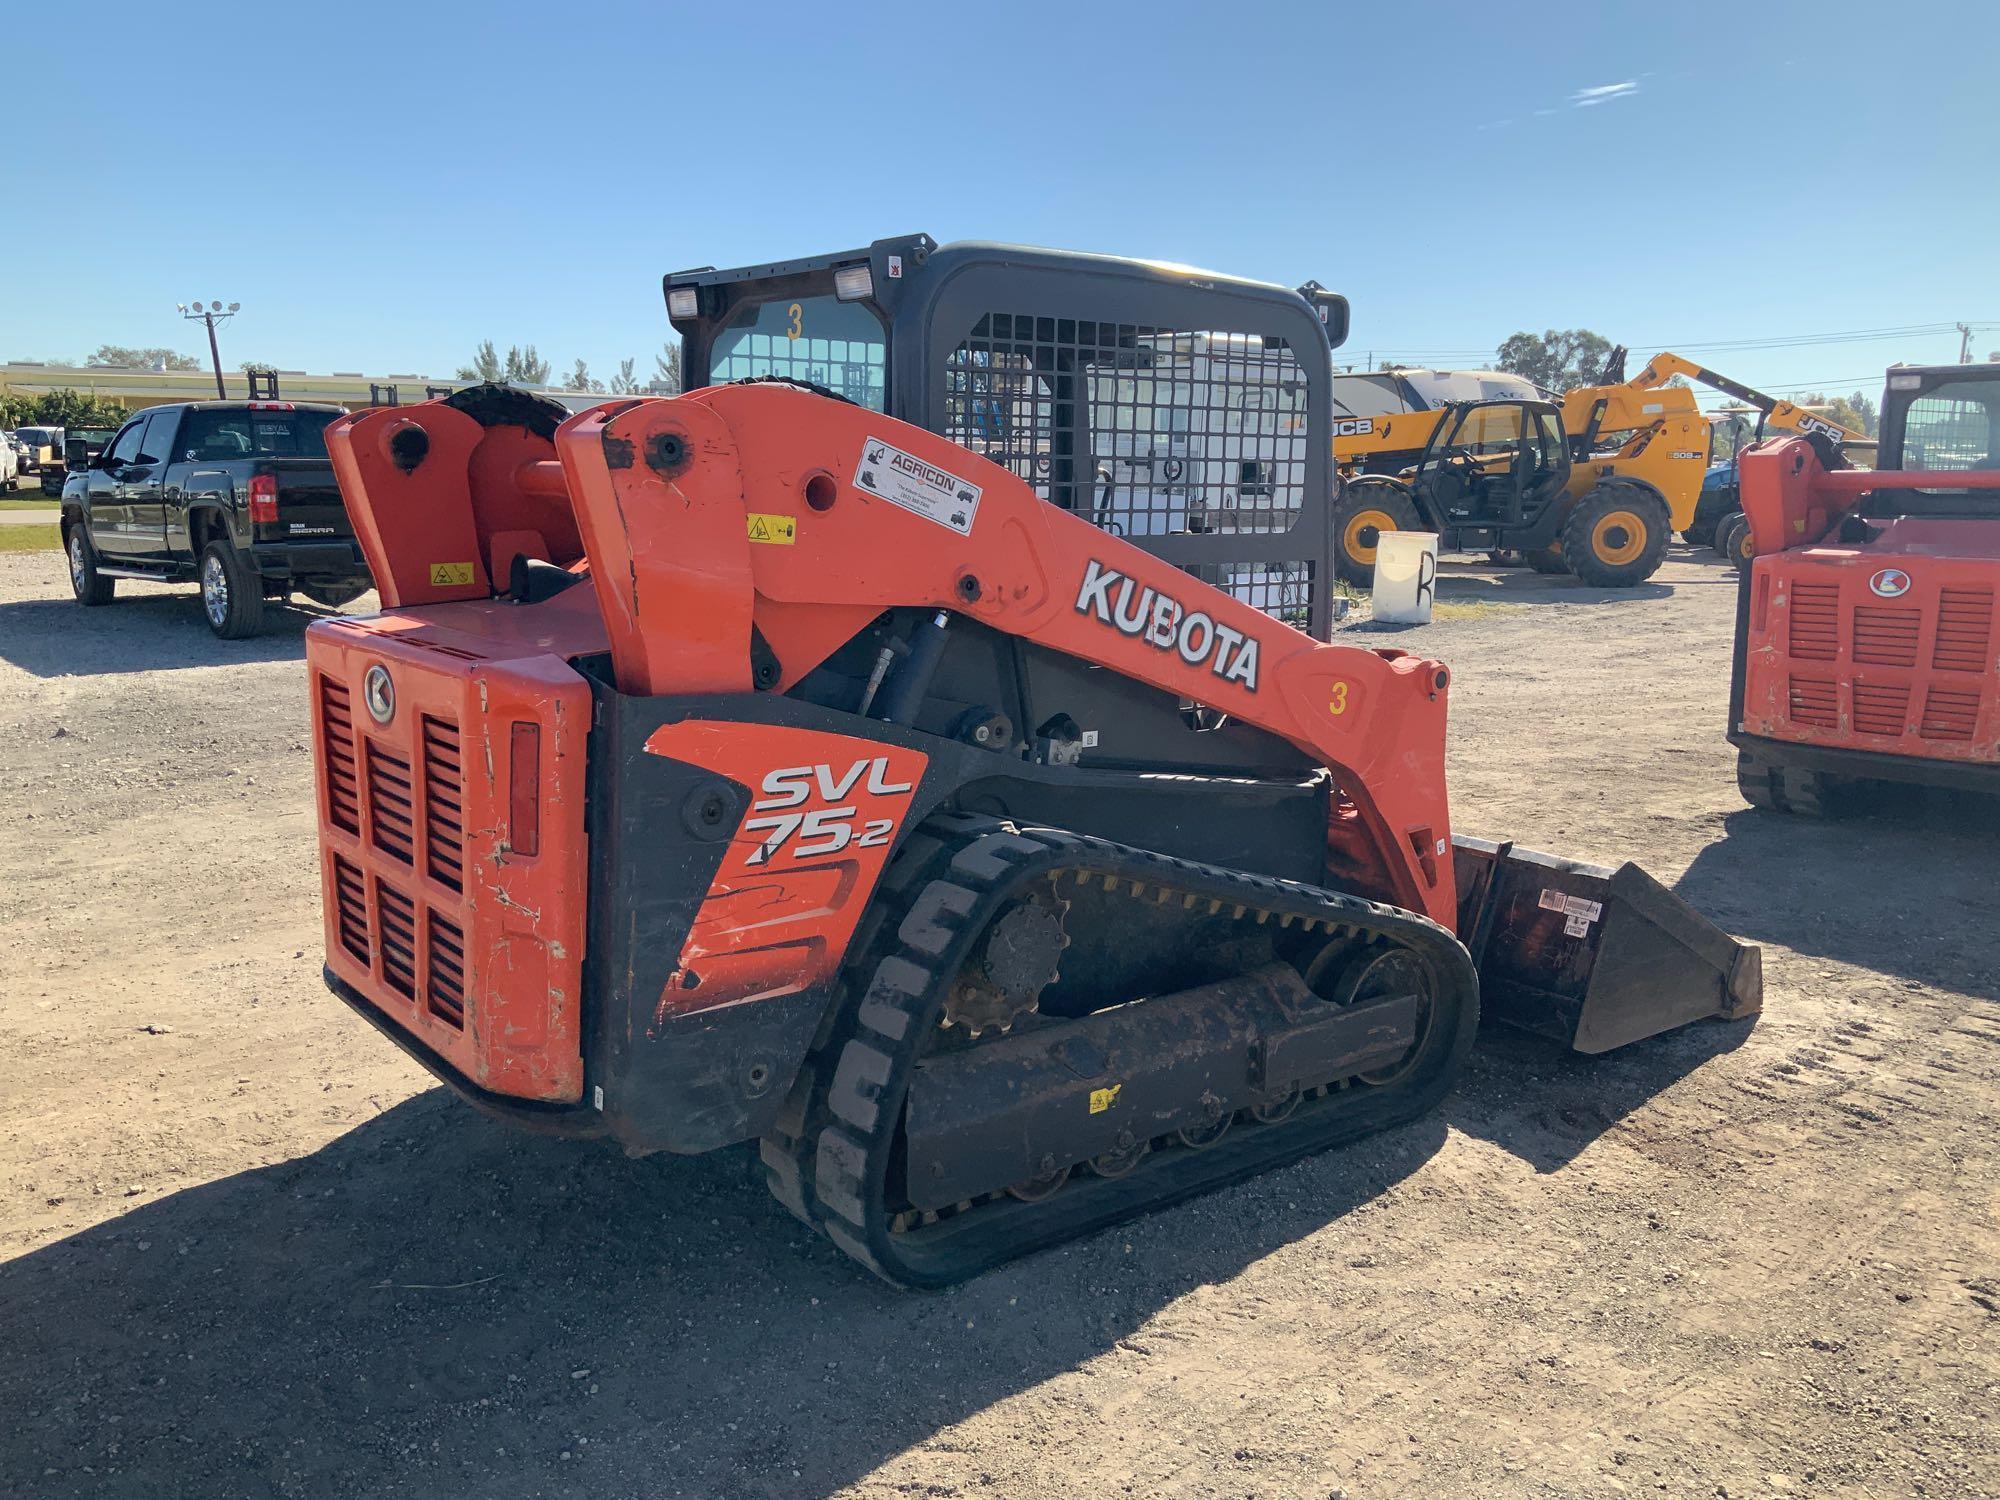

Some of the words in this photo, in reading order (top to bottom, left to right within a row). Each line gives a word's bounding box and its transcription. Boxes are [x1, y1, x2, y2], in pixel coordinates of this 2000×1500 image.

[787, 303, 803, 341] 3
[1799, 416, 1845, 444] JCB
[891, 454, 955, 491] AGRICON
[1416, 550, 1435, 609] R
[1075, 559, 1260, 692] KUBOTA
[1329, 681, 1348, 715] 3
[753, 757, 913, 811] SVL
[744, 806, 894, 866] 75-2
